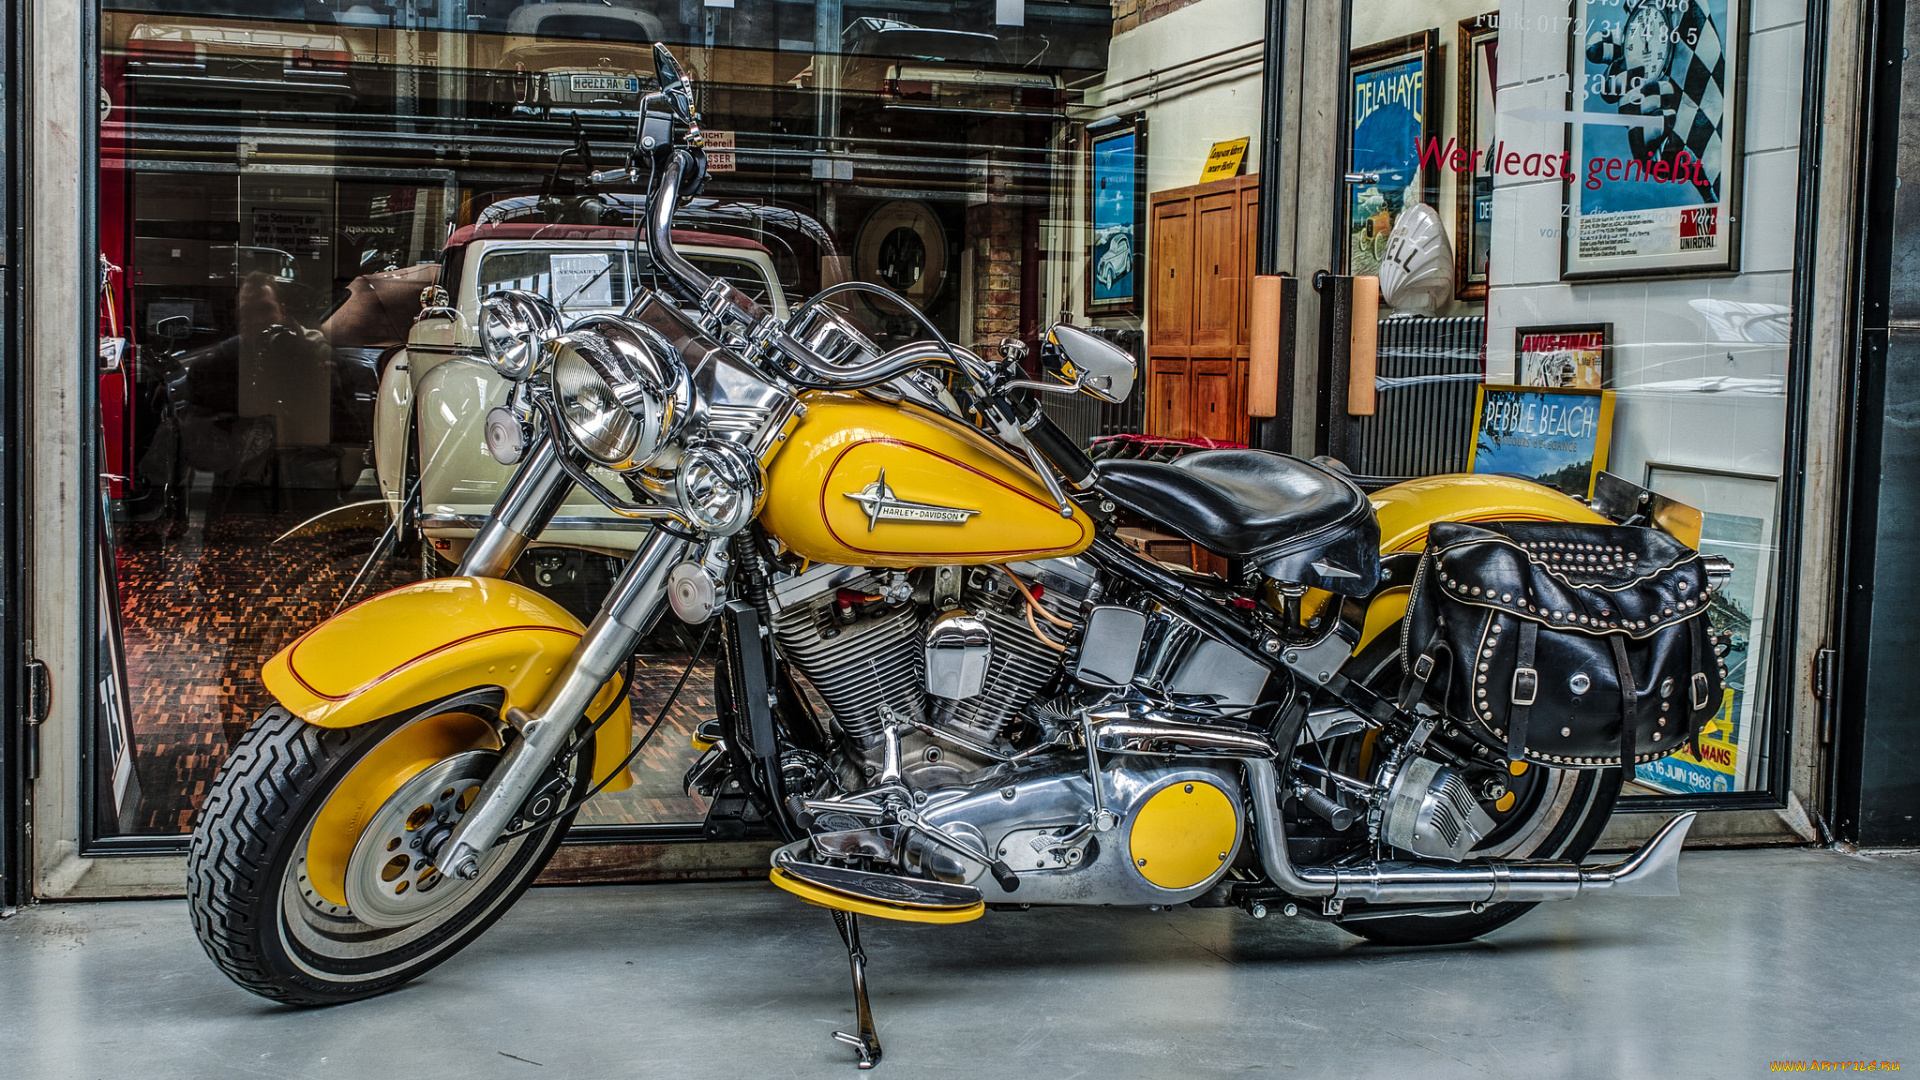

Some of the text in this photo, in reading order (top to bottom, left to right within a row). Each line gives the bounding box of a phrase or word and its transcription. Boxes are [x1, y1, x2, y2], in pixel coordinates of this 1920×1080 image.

[1537, 14, 1595, 38] 0172/
[1601, 20, 1620, 38] 31
[1630, 22, 1652, 41] 74
[1659, 26, 1681, 44] 86
[1686, 28, 1698, 45] 5
[1356, 71, 1422, 130] DELAHAYE
[708, 154, 731, 163] SSER
[1414, 136, 1709, 190] Wer least, genießt.
[1386, 237, 1418, 273] ELL
[1680, 235, 1715, 250] UNIROYAL
[1522, 332, 1603, 352] AVUS-FINALE
[1485, 400, 1594, 439] PEBBLE BEACH
[882, 507, 959, 520] HARLEY-DAVIDSON
[1701, 744, 1731, 766] MANS
[1655, 761, 1664, 775] 16
[1665, 766, 1687, 783] JUIN
[1688, 771, 1711, 790] 1968
